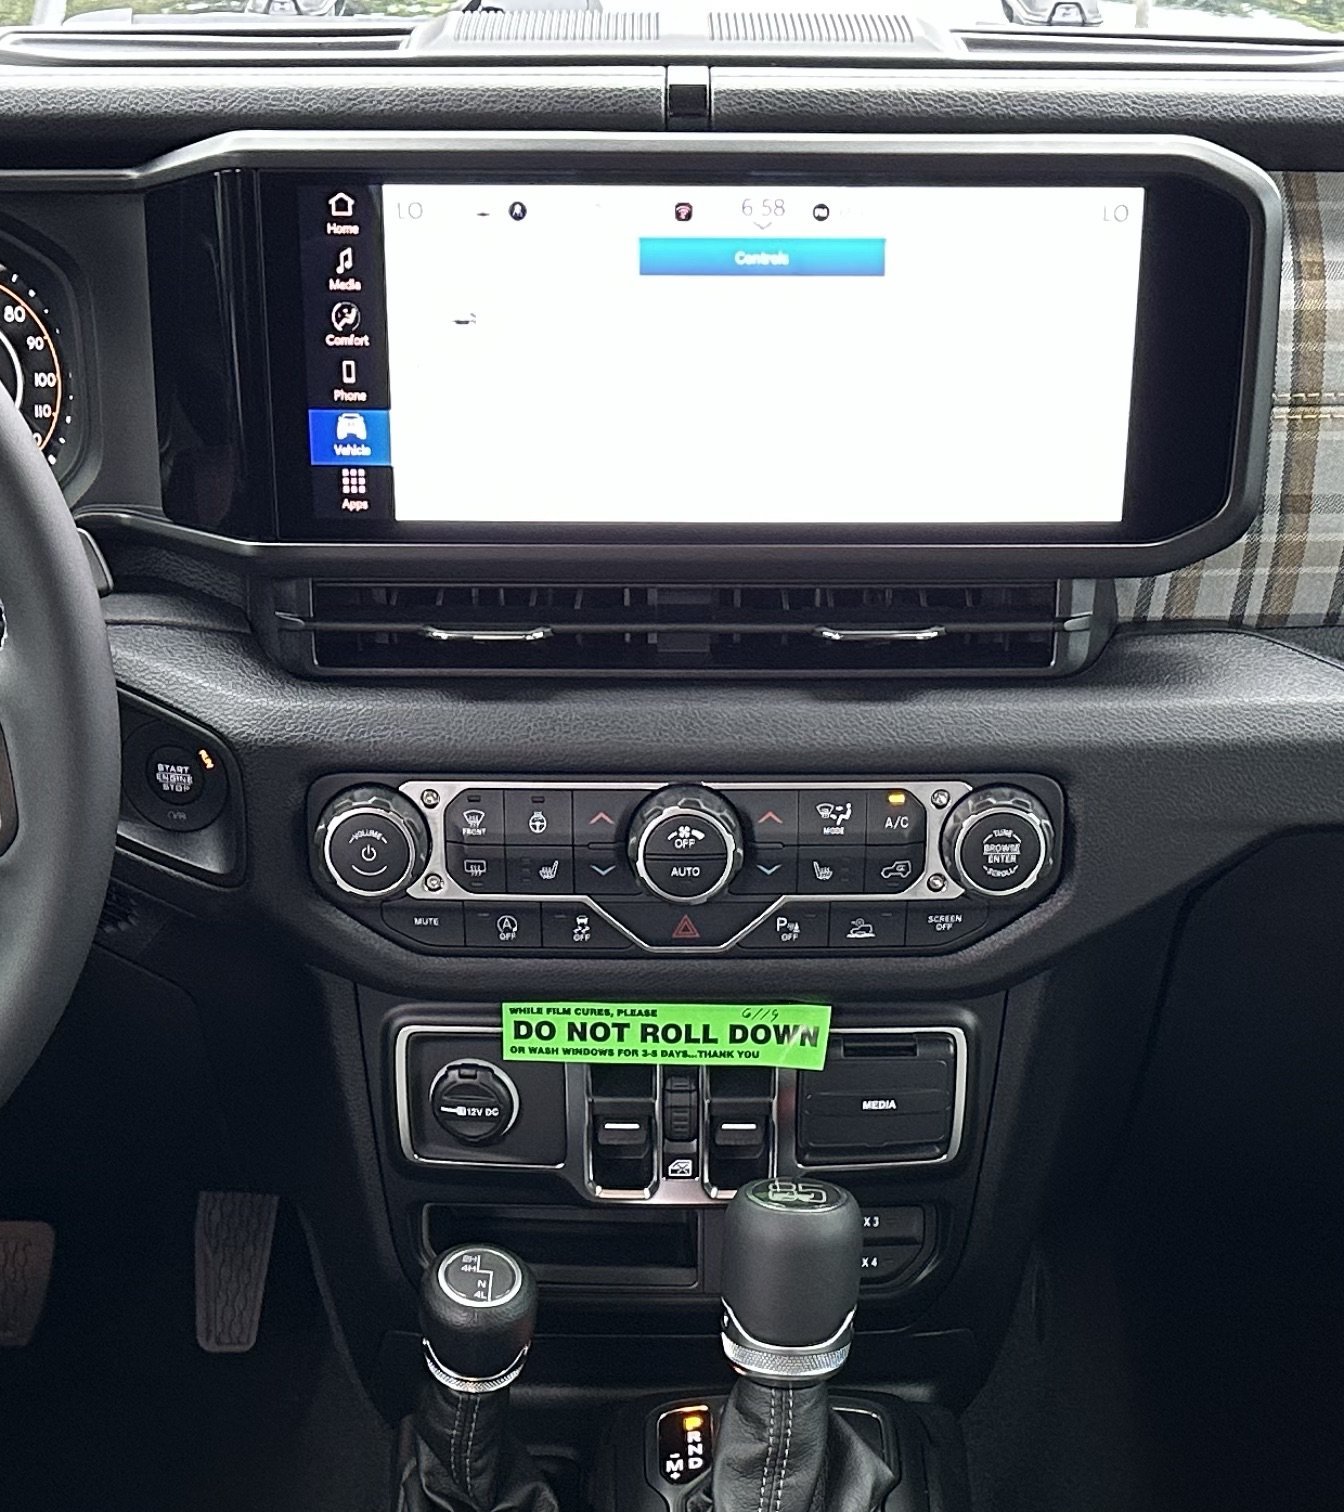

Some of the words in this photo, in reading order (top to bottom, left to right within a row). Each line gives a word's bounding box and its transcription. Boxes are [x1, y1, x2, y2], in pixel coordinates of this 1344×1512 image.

[741, 199, 785, 216] 658
[327, 222, 359, 234] Home
[329, 278, 361, 291] Media
[4, 305, 26, 322] 80
[26, 336, 44, 351] 90
[325, 334, 370, 346] Comfort
[34, 373, 56, 388] 100
[334, 388, 367, 401] Phone
[34, 404, 52, 418] 110
[334, 443, 371, 456] Vehicle
[342, 498, 368, 512] Apps
[157, 763, 189, 774] START
[156, 772, 193, 785] ENGINE
[162, 783, 190, 792] STOP
[885, 816, 909, 829] A/C
[352, 829, 382, 839] VOLUME
[823, 827, 844, 835] MODE
[674, 838, 696, 849] OFF
[983, 843, 1020, 852] BROWSE
[988, 854, 1016, 863] ENTER
[671, 867, 700, 877] AUTO
[414, 917, 439, 926] MUTE
[928, 915, 962, 924] SCREEN
[936, 923, 952, 931] OFF
[499, 932, 516, 941] OFF
[573, 933, 591, 942] OFF
[781, 933, 798, 941] OFF
[509, 1007, 543, 1015] WHILE
[546, 1008, 571, 1016] FILM
[574, 1008, 614, 1017] CURES,
[617, 1009, 658, 1017] PLEASE
[513, 1020, 556, 1041] DO
[567, 1021, 630, 1043] NOT
[640, 1023, 718, 1044] ROLL
[729, 1023, 820, 1048] DOWN
[510, 1046, 526, 1054] OR
[528, 1046, 559, 1055] WASH
[562, 1047, 614, 1056] WINDOWS
[617, 1049, 639, 1057] FOR
[738, 1050, 760, 1059] YOU
[862, 1100, 897, 1110] MEDIA
[467, 1107, 483, 1116] 12V
[485, 1108, 500, 1116] DC
[872, 1216, 880, 1228] 3
[870, 1257, 878, 1268] 4
[460, 1264, 476, 1273] 4H
[477, 1279, 487, 1289] N
[473, 1290, 487, 1299] 4L
[684, 1416, 702, 1431] P
[687, 1431, 702, 1443] R
[687, 1443, 703, 1456] N
[665, 1458, 684, 1473] M
[688, 1457, 703, 1469] D
